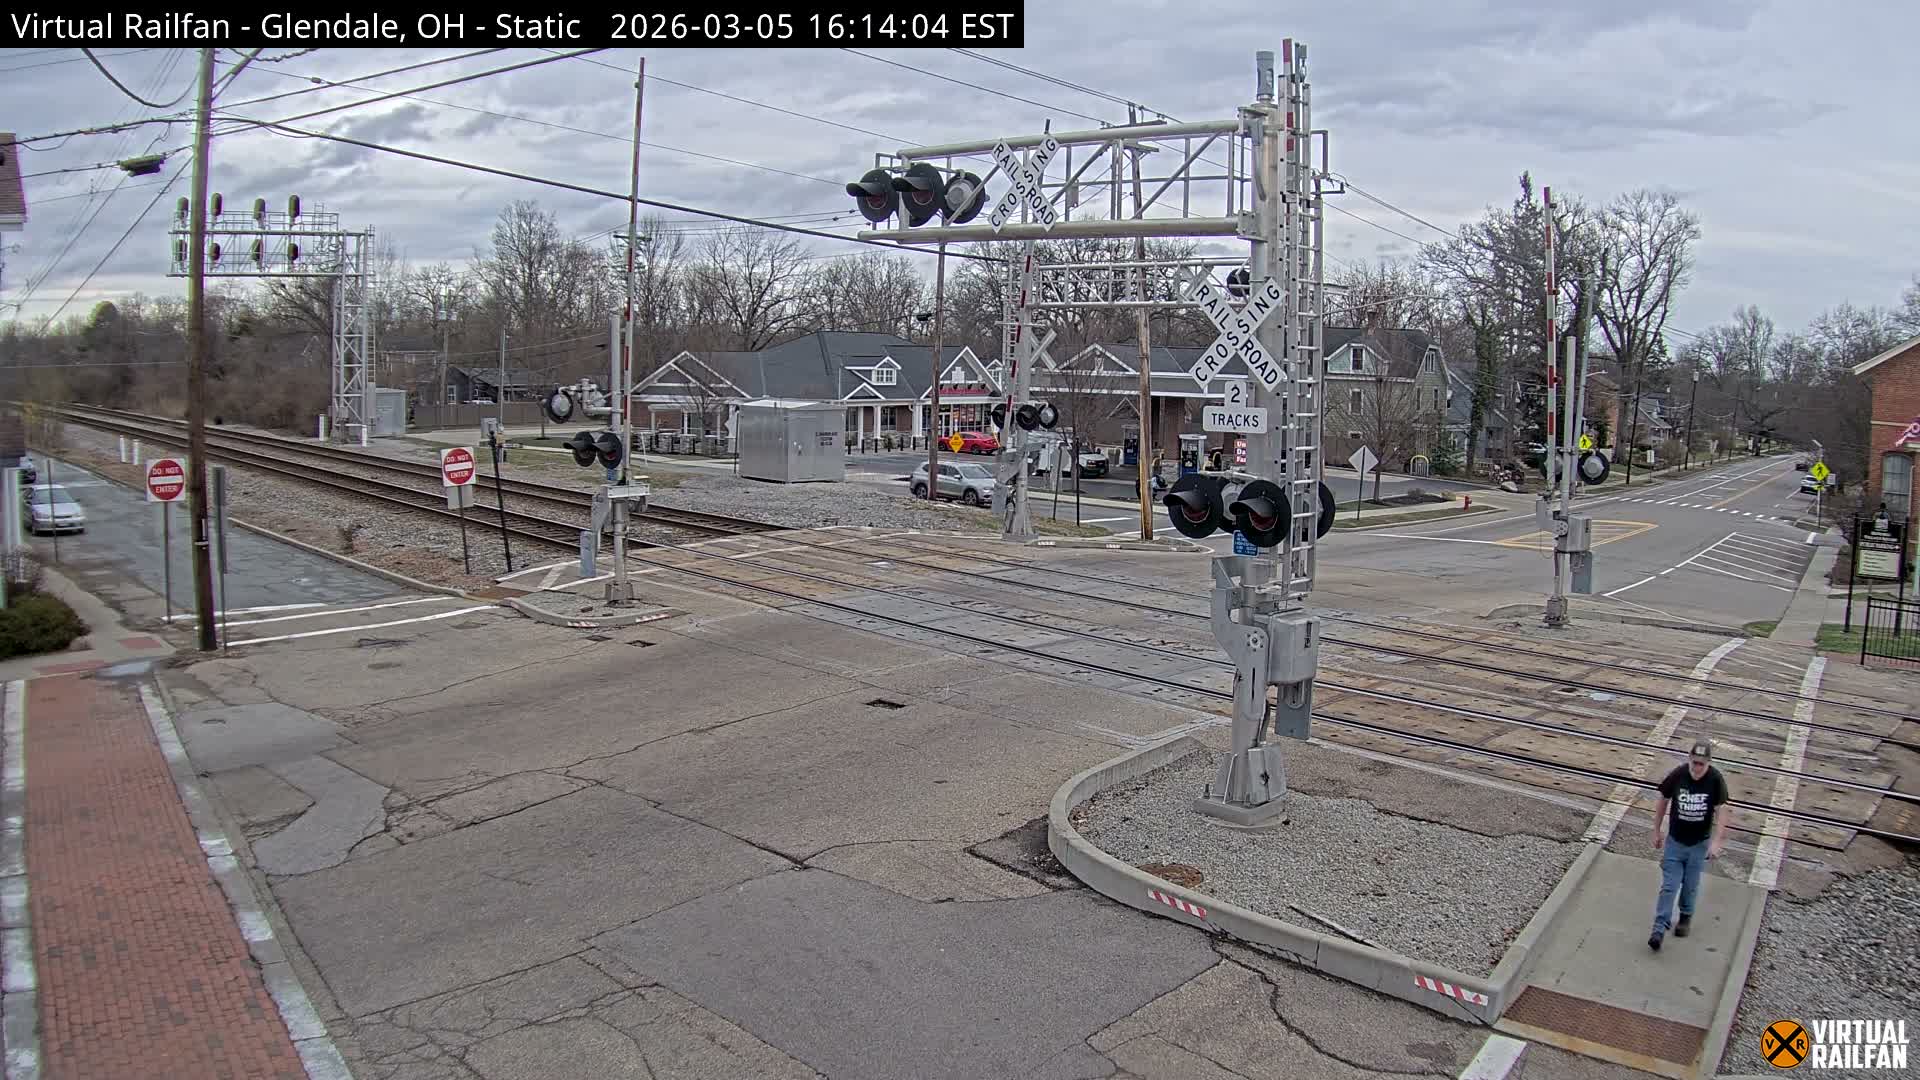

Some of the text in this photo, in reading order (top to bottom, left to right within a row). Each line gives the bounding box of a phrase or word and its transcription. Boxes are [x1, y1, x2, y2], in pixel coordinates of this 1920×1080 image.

[991, 139, 1056, 227] CROSSING
[1194, 284, 1281, 383] CROSSING
[1230, 386, 1241, 403] 2
[1211, 412, 1260, 428] TRACKS
[152, 466, 179, 475] DO NOT
[450, 470, 469, 479] ENTER
[155, 485, 178, 493] ENTER
